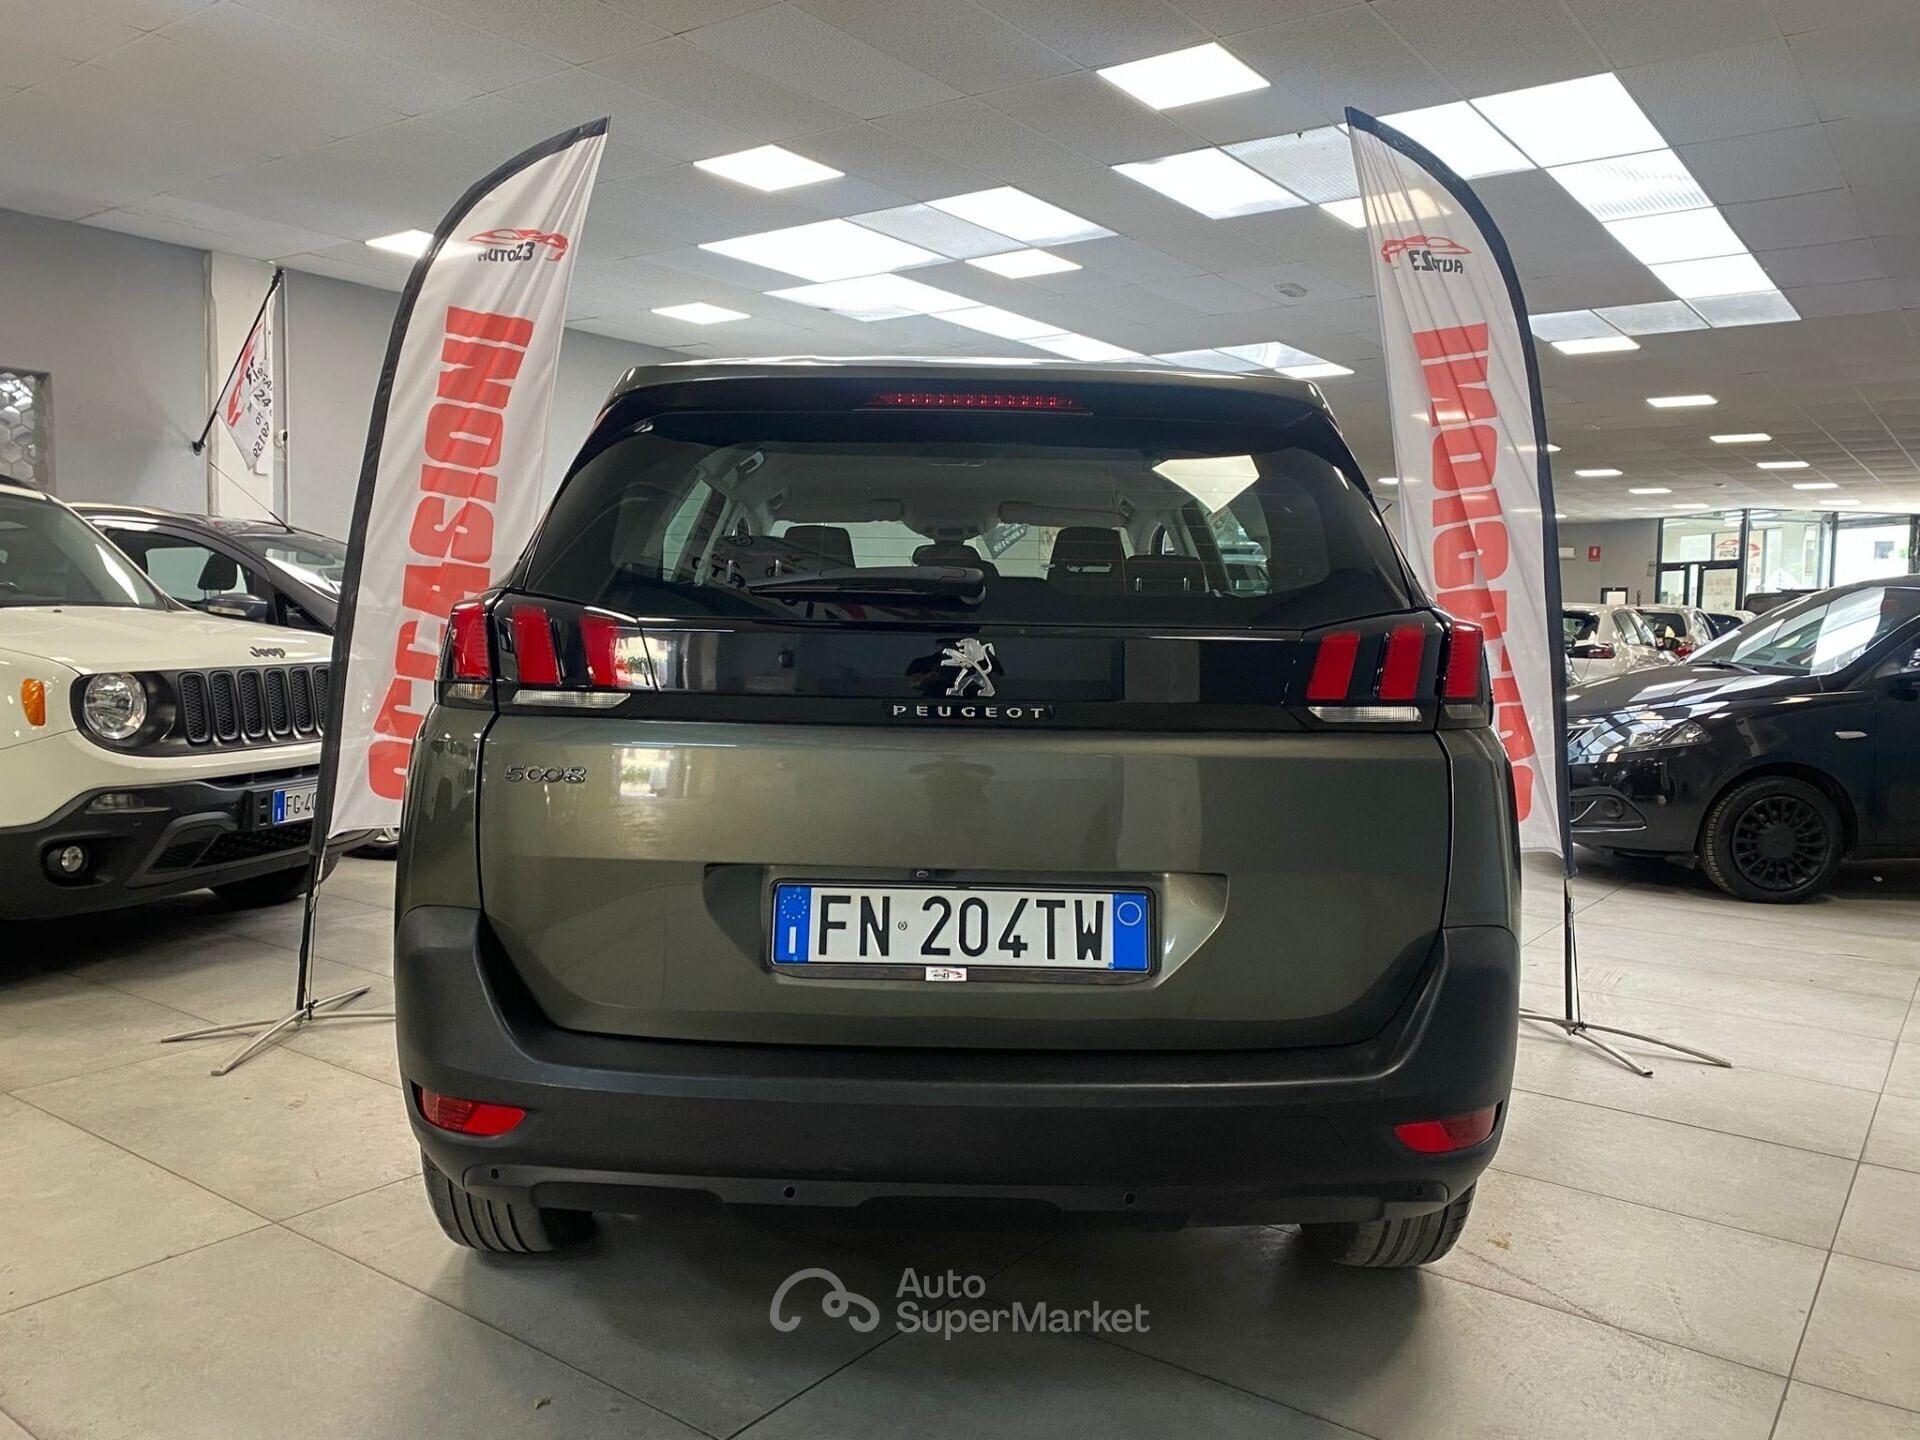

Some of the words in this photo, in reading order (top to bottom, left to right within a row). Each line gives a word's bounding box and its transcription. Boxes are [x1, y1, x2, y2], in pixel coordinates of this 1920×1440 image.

[893, 704, 1045, 719] PEUGEOT
[505, 765, 586, 784] 5008
[304, 792, 318, 812] 40
[818, 895, 890, 957] FN
[920, 896, 1105, 961] 204TW
